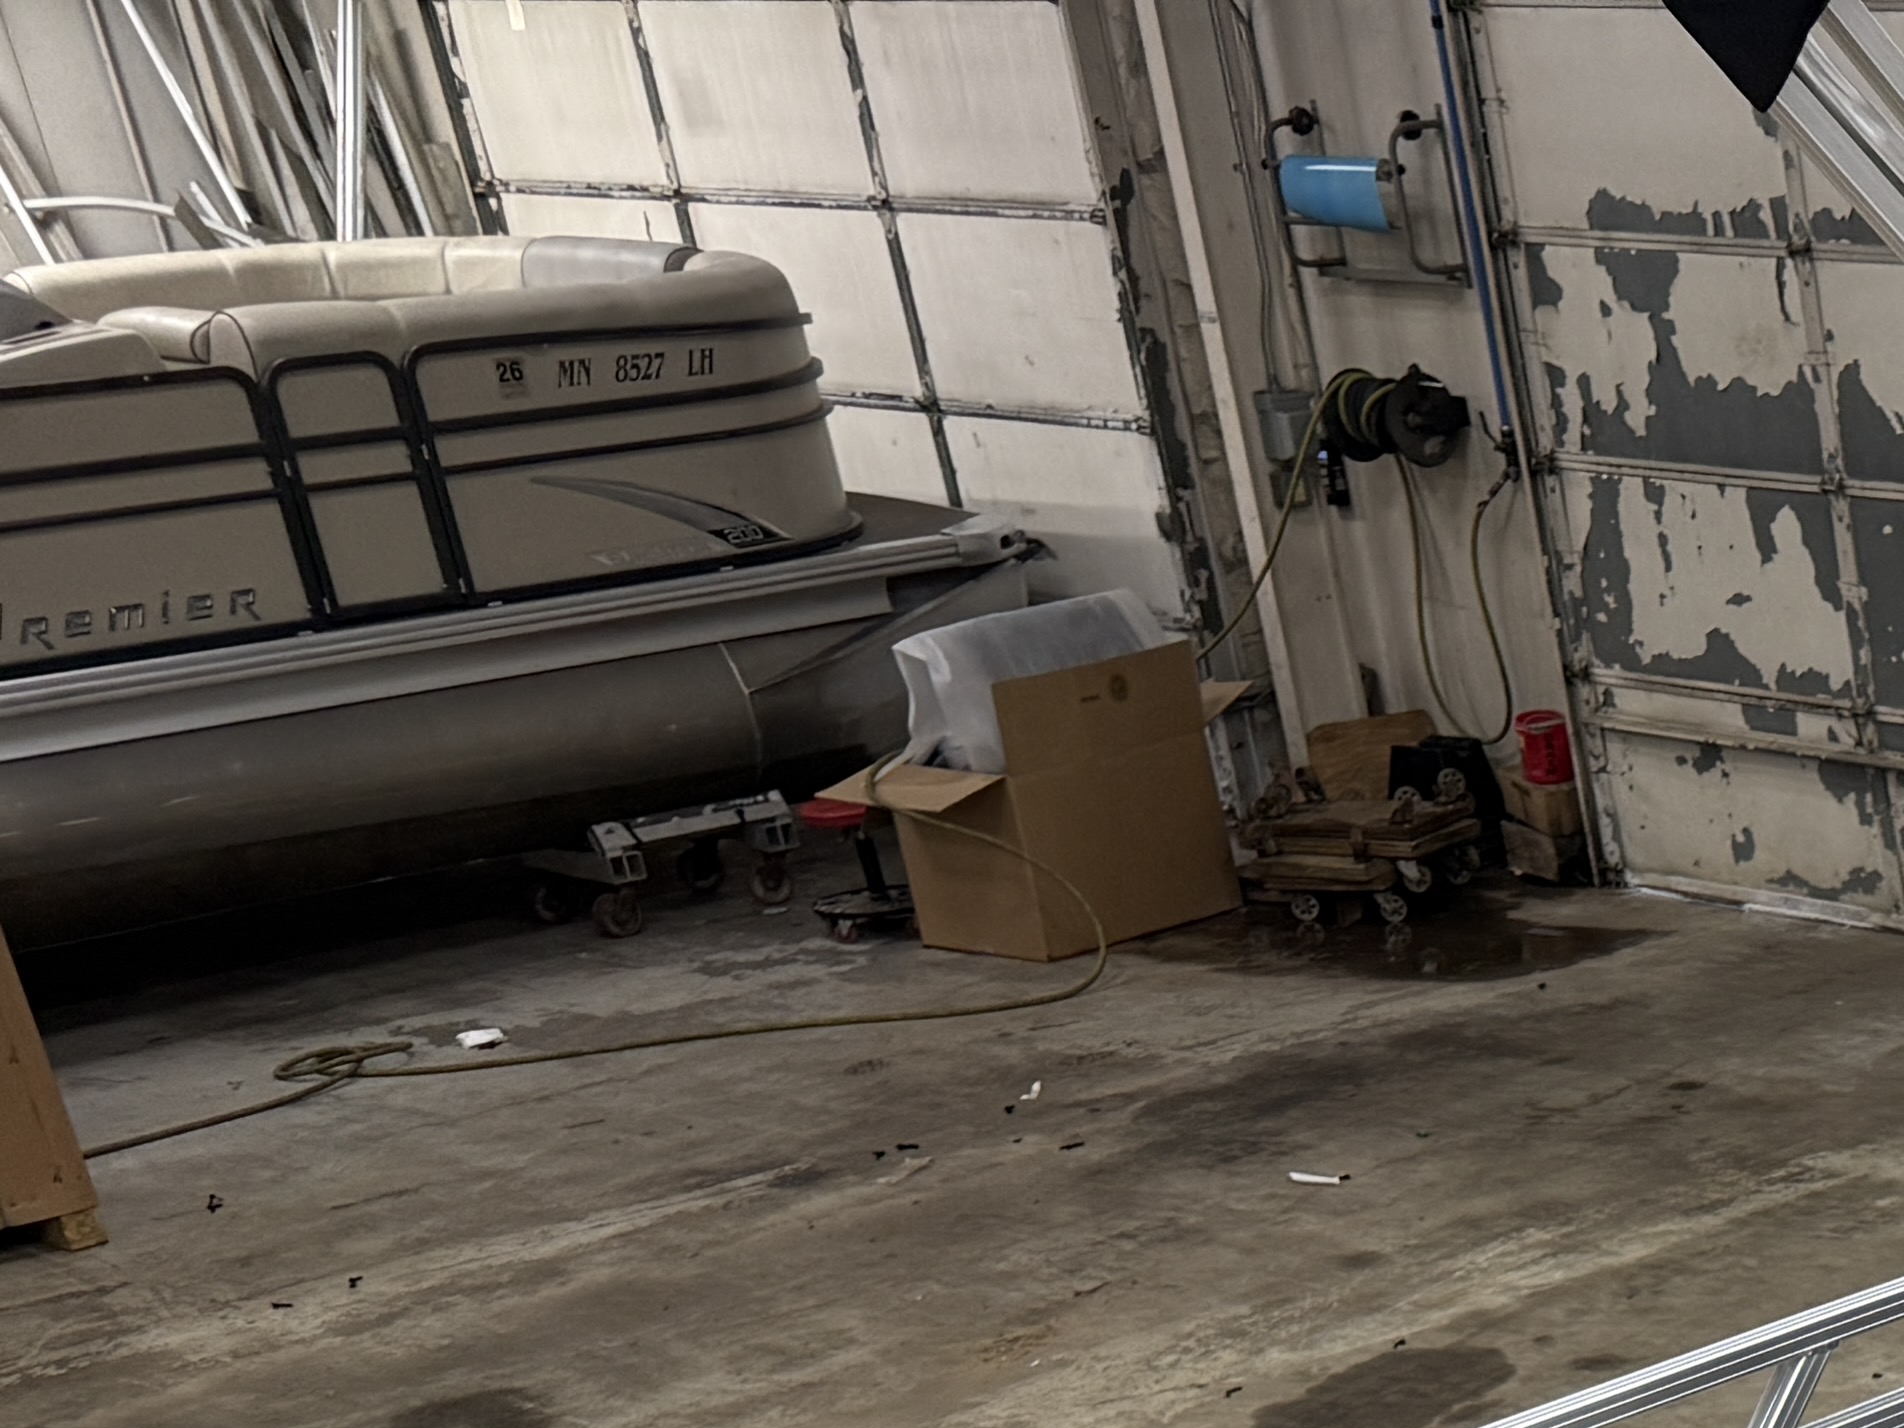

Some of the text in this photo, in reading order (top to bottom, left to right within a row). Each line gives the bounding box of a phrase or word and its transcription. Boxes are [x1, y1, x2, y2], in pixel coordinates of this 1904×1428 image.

[497, 362, 524, 383] 26
[557, 347, 714, 388] MN 8527 LH
[724, 525, 764, 545] 200
